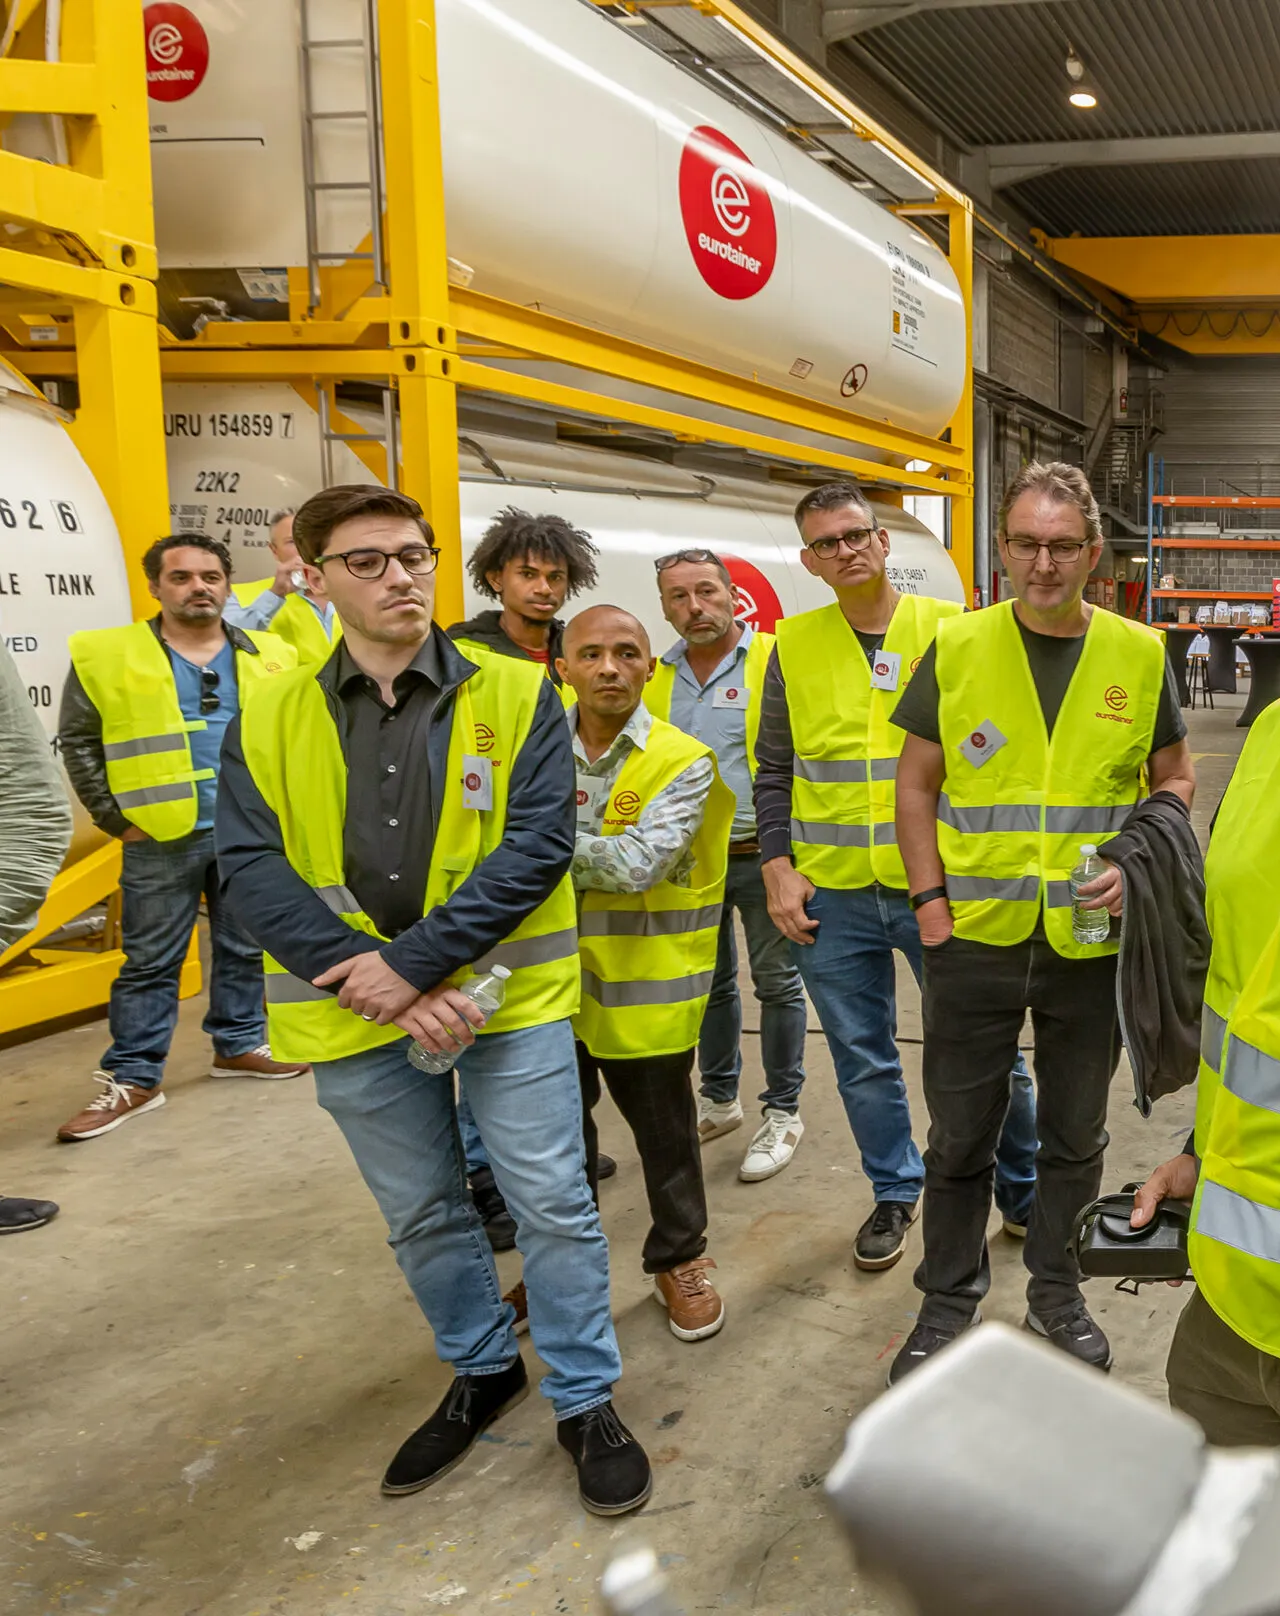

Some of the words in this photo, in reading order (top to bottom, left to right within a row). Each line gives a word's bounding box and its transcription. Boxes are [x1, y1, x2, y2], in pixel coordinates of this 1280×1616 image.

[698, 232, 762, 275] eurotainer
[209, 413, 273, 437] 154859
[281, 413, 292, 437] 7
[194, 470, 241, 493] 22K2
[216, 506, 271, 527] 24000L
[222, 528, 232, 546] 4
[44, 572, 96, 597] TANK
